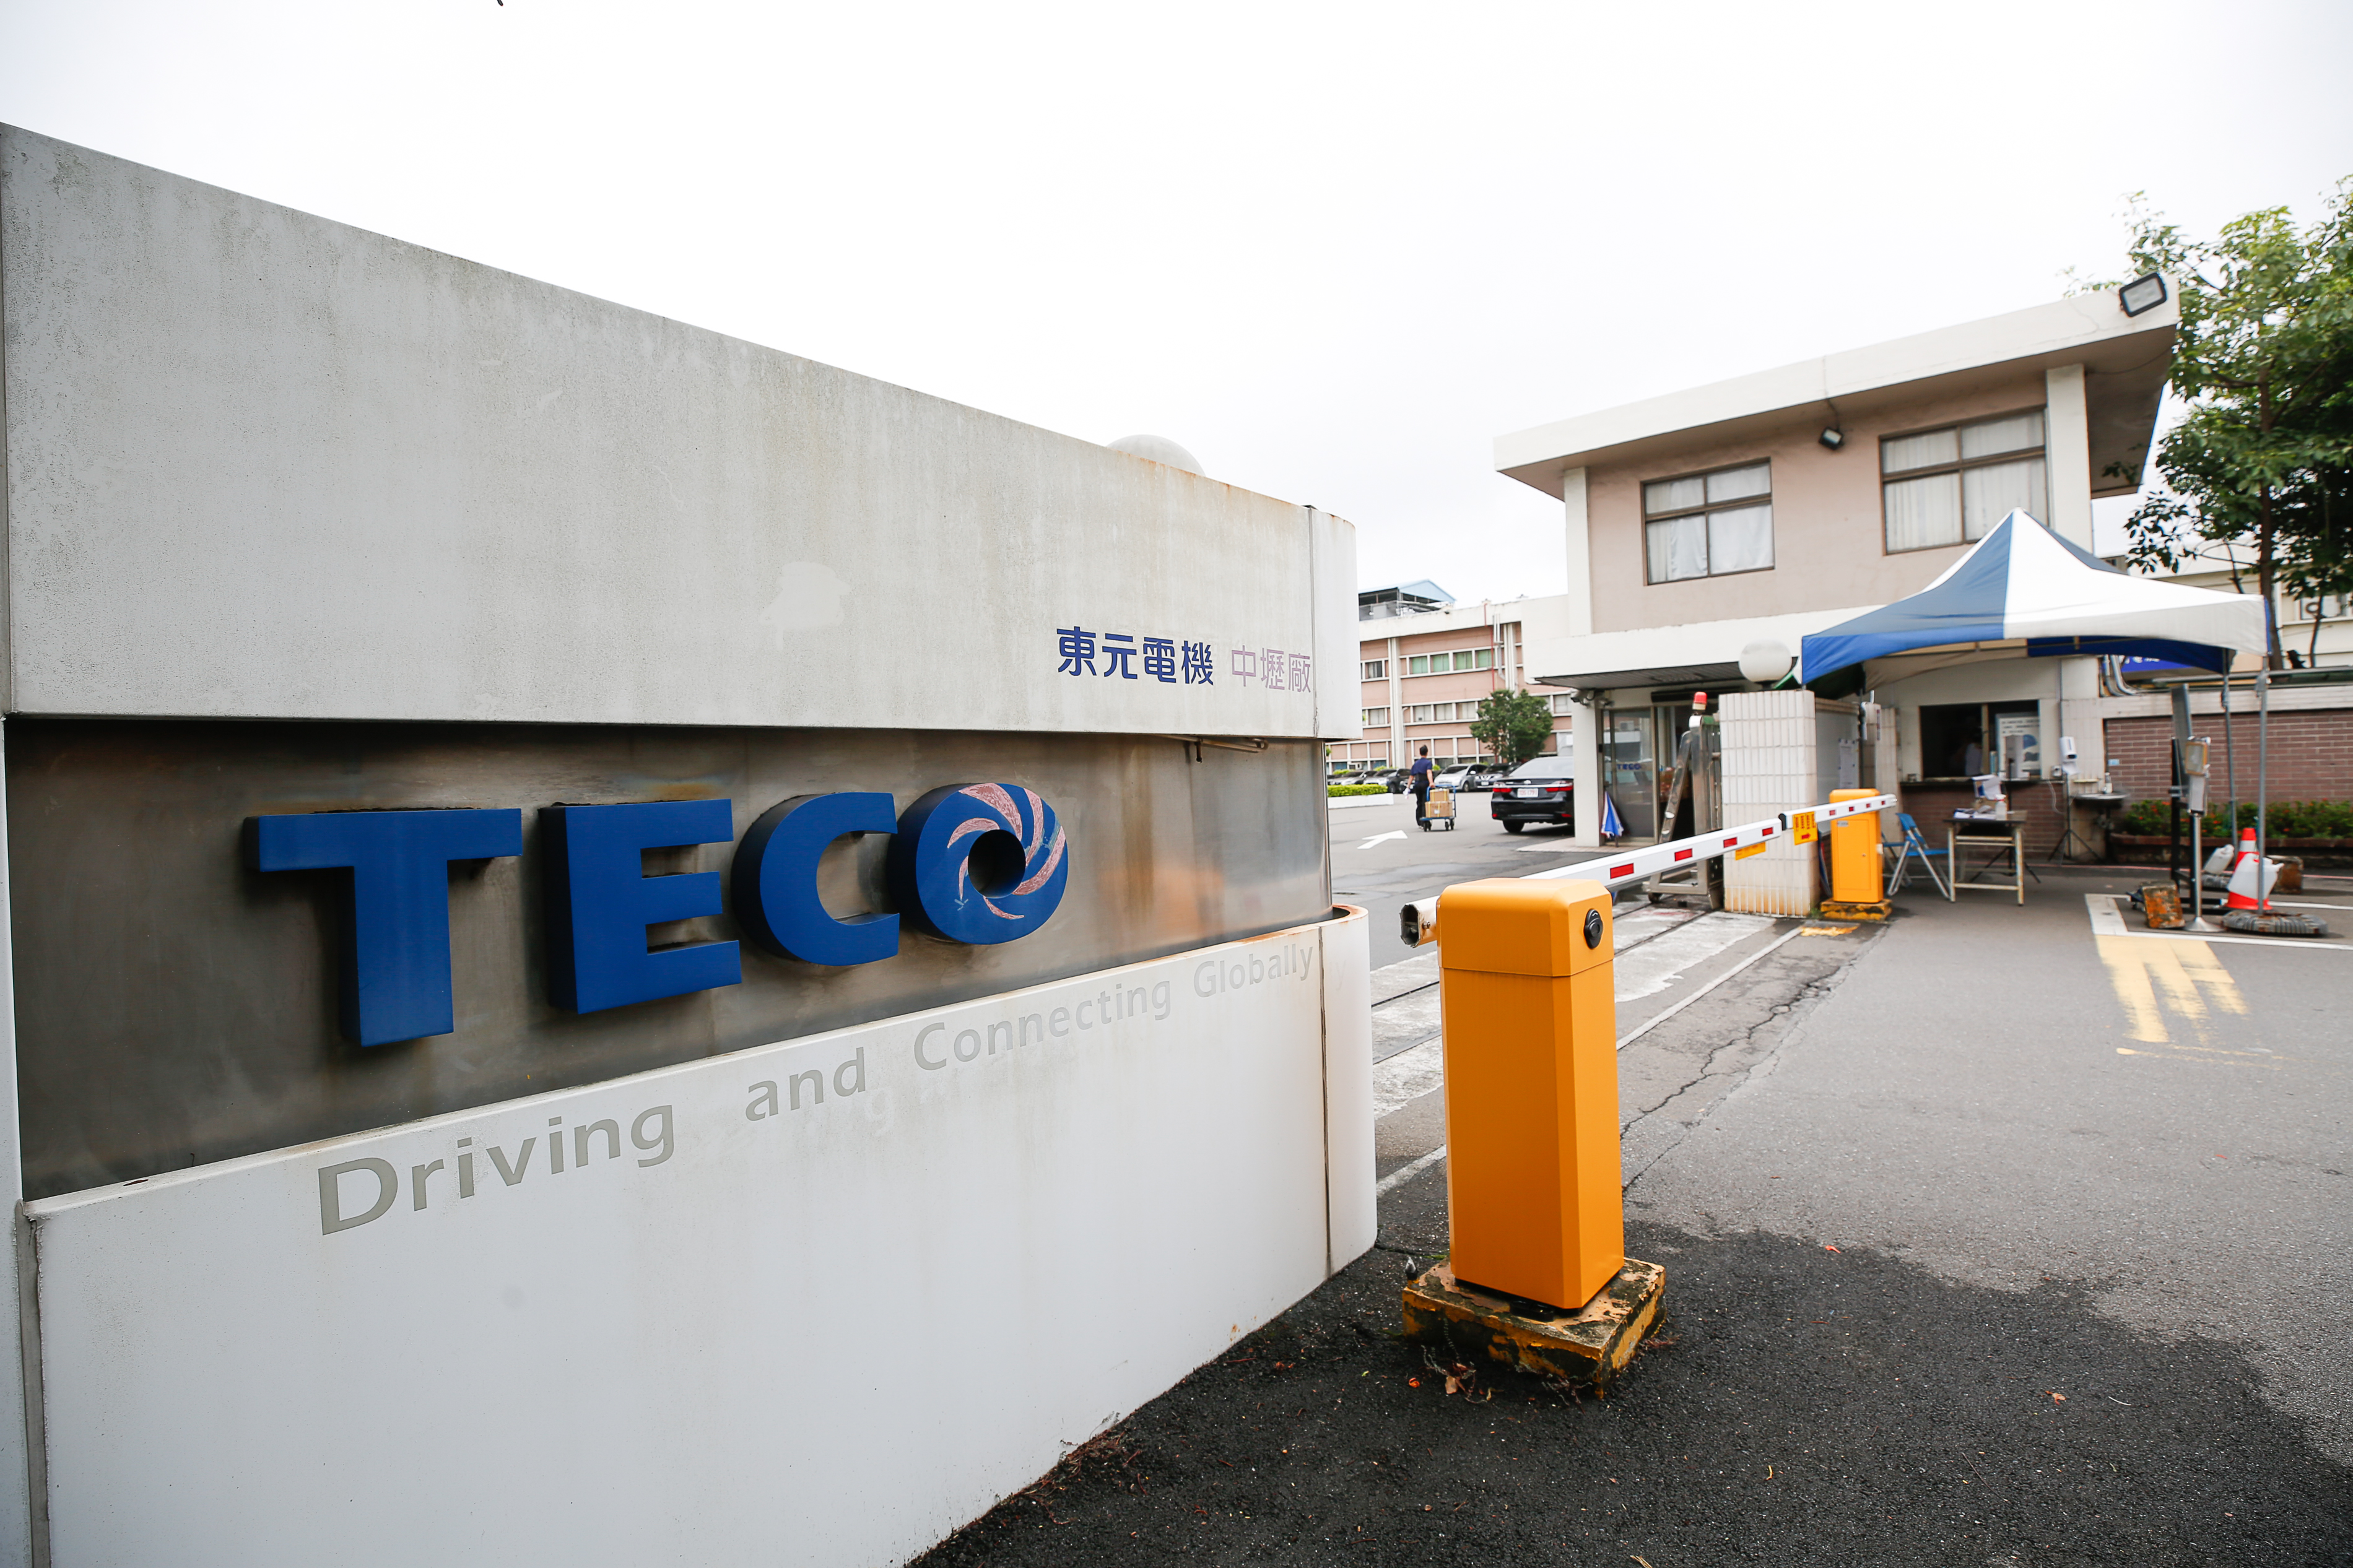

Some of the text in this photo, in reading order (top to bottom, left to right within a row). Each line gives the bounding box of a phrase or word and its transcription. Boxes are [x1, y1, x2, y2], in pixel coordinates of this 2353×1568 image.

[1056, 626, 1311, 693] 東元電機 中壢廠
[245, 782, 1069, 1047] TECO
[318, 1104, 675, 1236] Driving
[745, 1047, 866, 1122] and
[914, 980, 1171, 1071] Connecting
[1193, 943, 1313, 998] Globally
